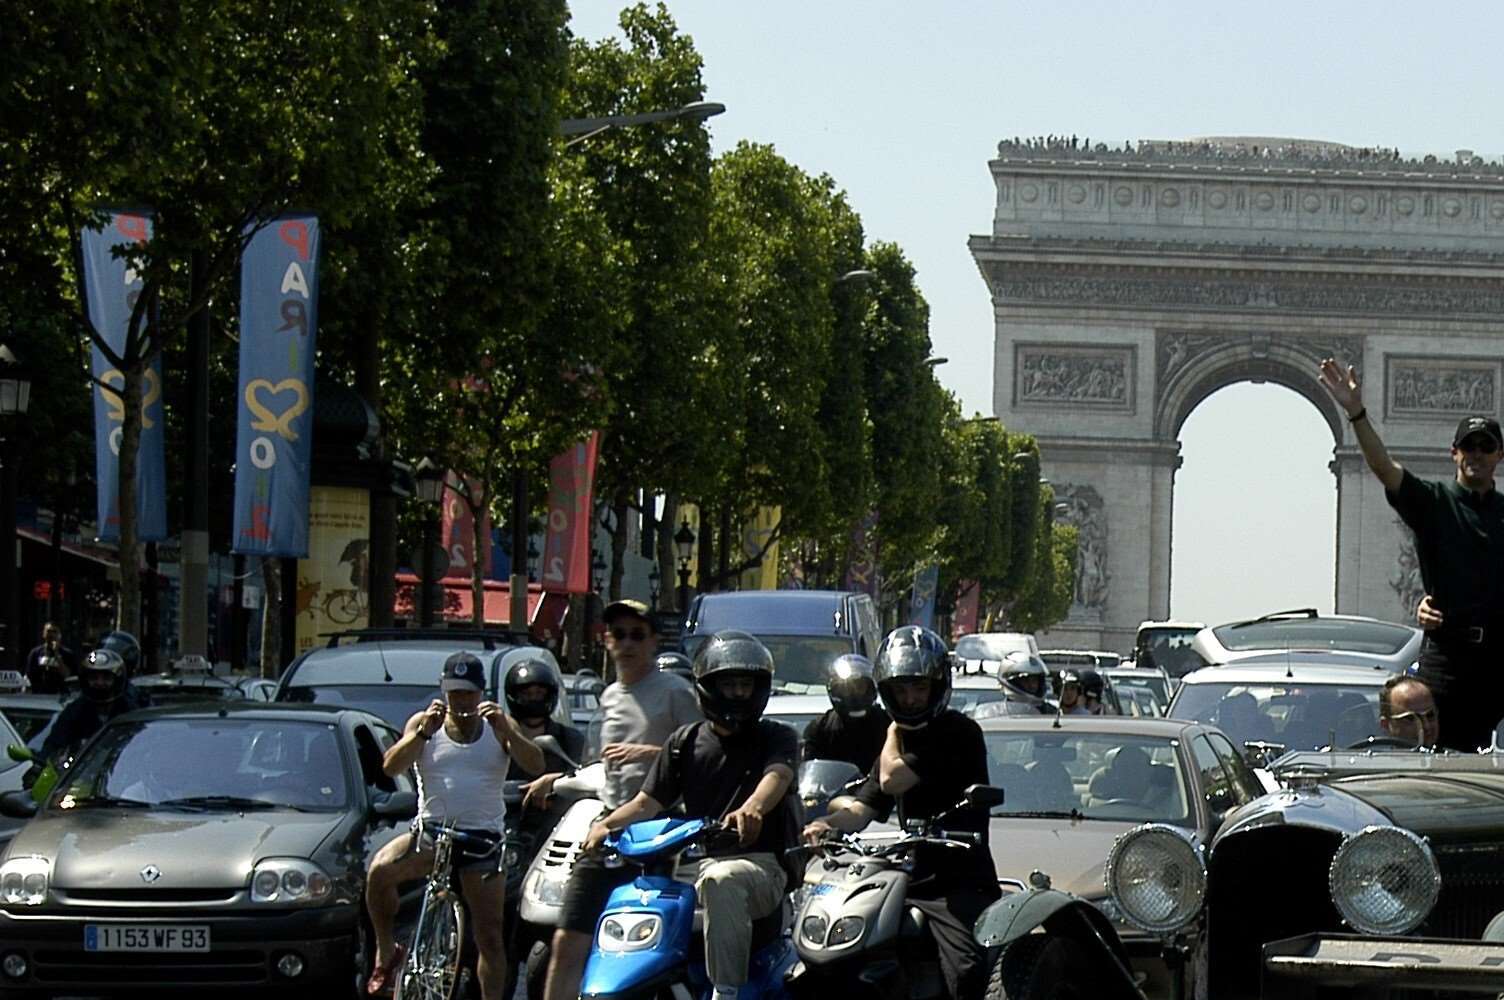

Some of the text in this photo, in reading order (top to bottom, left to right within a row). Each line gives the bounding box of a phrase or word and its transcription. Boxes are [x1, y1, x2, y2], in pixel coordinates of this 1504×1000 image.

[103, 928, 206, 948] 1153 WF 93
